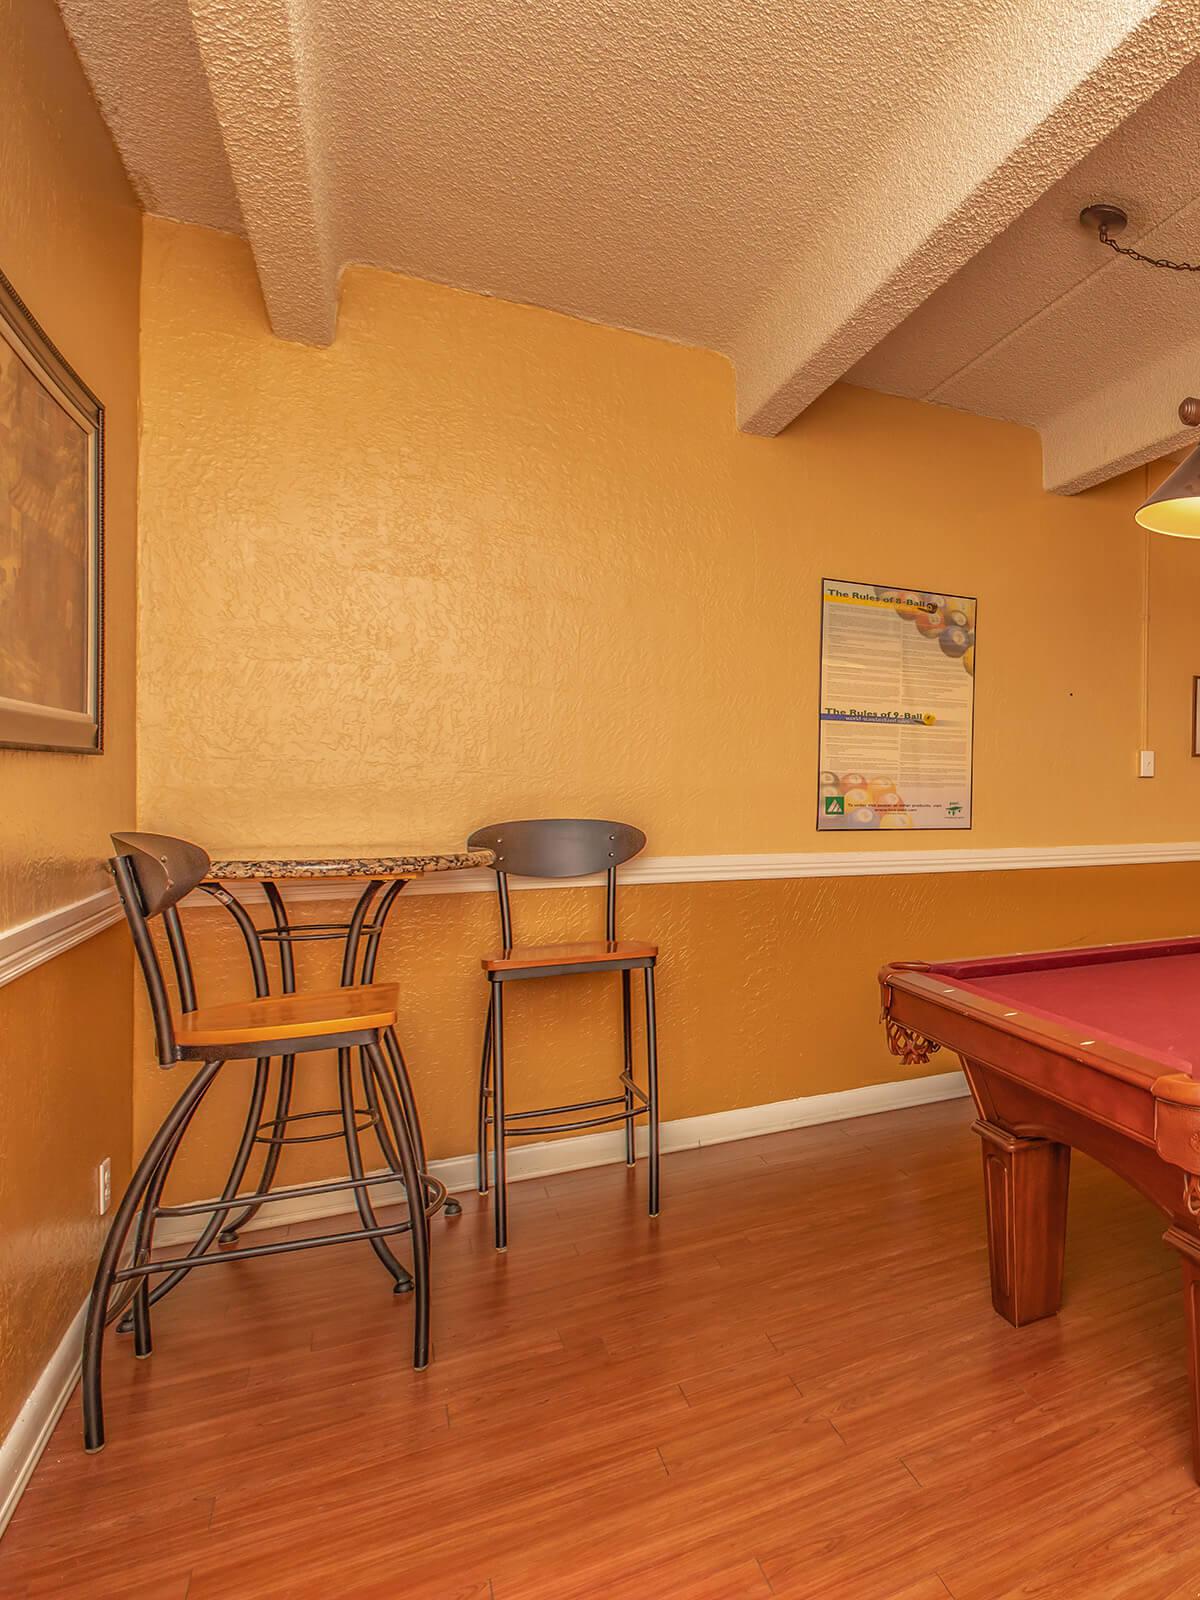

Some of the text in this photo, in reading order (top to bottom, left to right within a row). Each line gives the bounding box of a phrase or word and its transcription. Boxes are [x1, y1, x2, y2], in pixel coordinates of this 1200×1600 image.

[828, 589, 849, 598] The
[852, 592, 880, 602] Rules
[849, 709, 877, 718] Rules
[894, 711, 923, 720] 9-Ball
